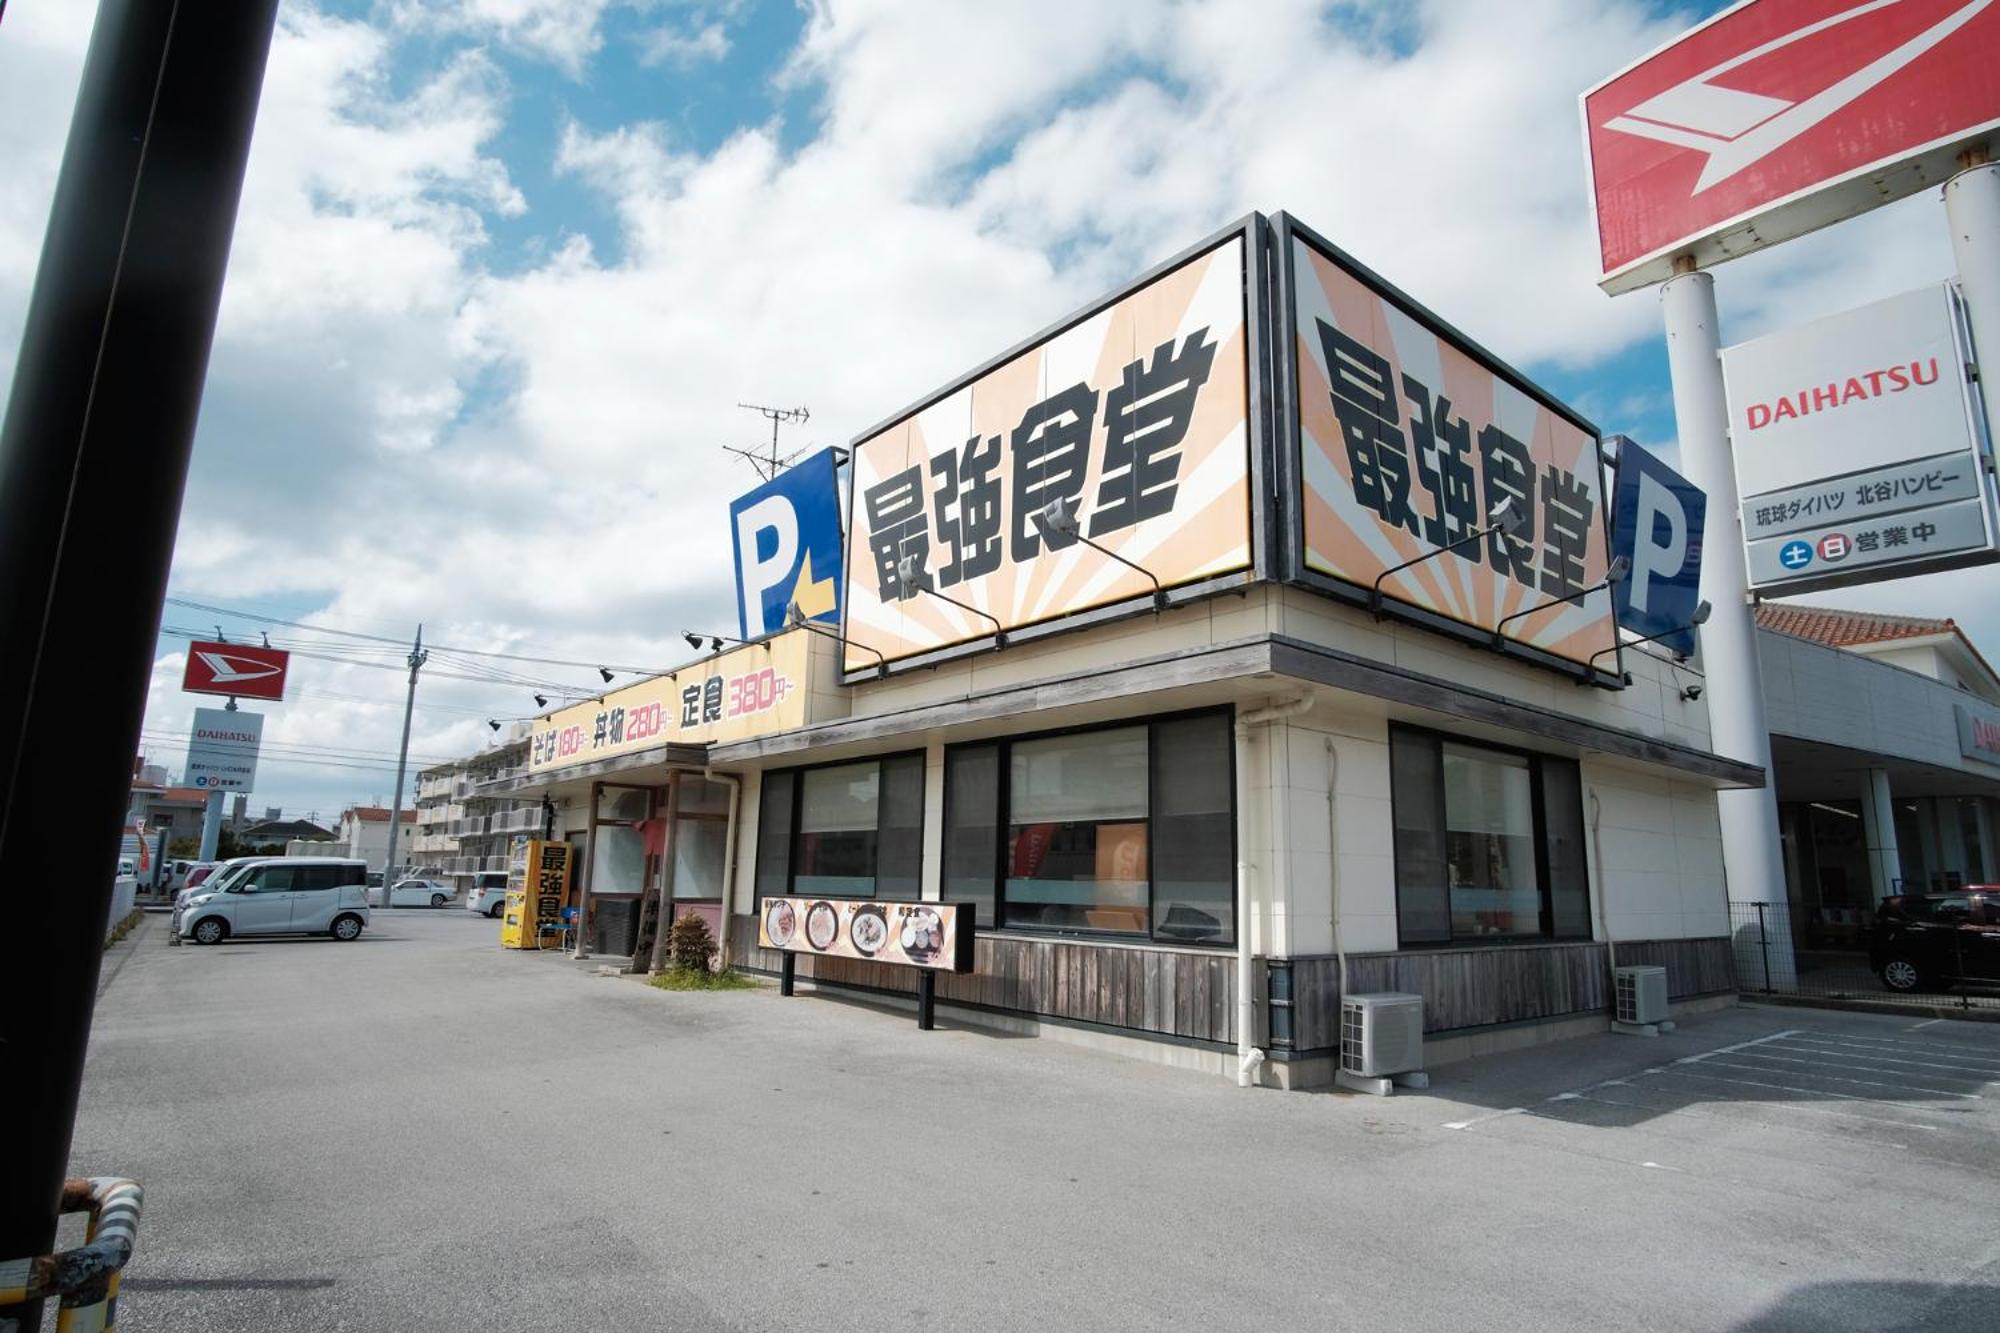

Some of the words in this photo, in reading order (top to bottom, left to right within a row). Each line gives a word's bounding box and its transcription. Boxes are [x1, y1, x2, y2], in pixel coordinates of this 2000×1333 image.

[864, 326, 1218, 603] 最強食堂
[1315, 317, 1594, 608] 最強食堂
[1747, 358, 1939, 430] DAIHATSU
[737, 495, 799, 640] P
[1629, 471, 1688, 612] P
[1756, 491, 1845, 526] 琉球ダイハツ
[1856, 471, 1960, 506] 北谷ハンビー
